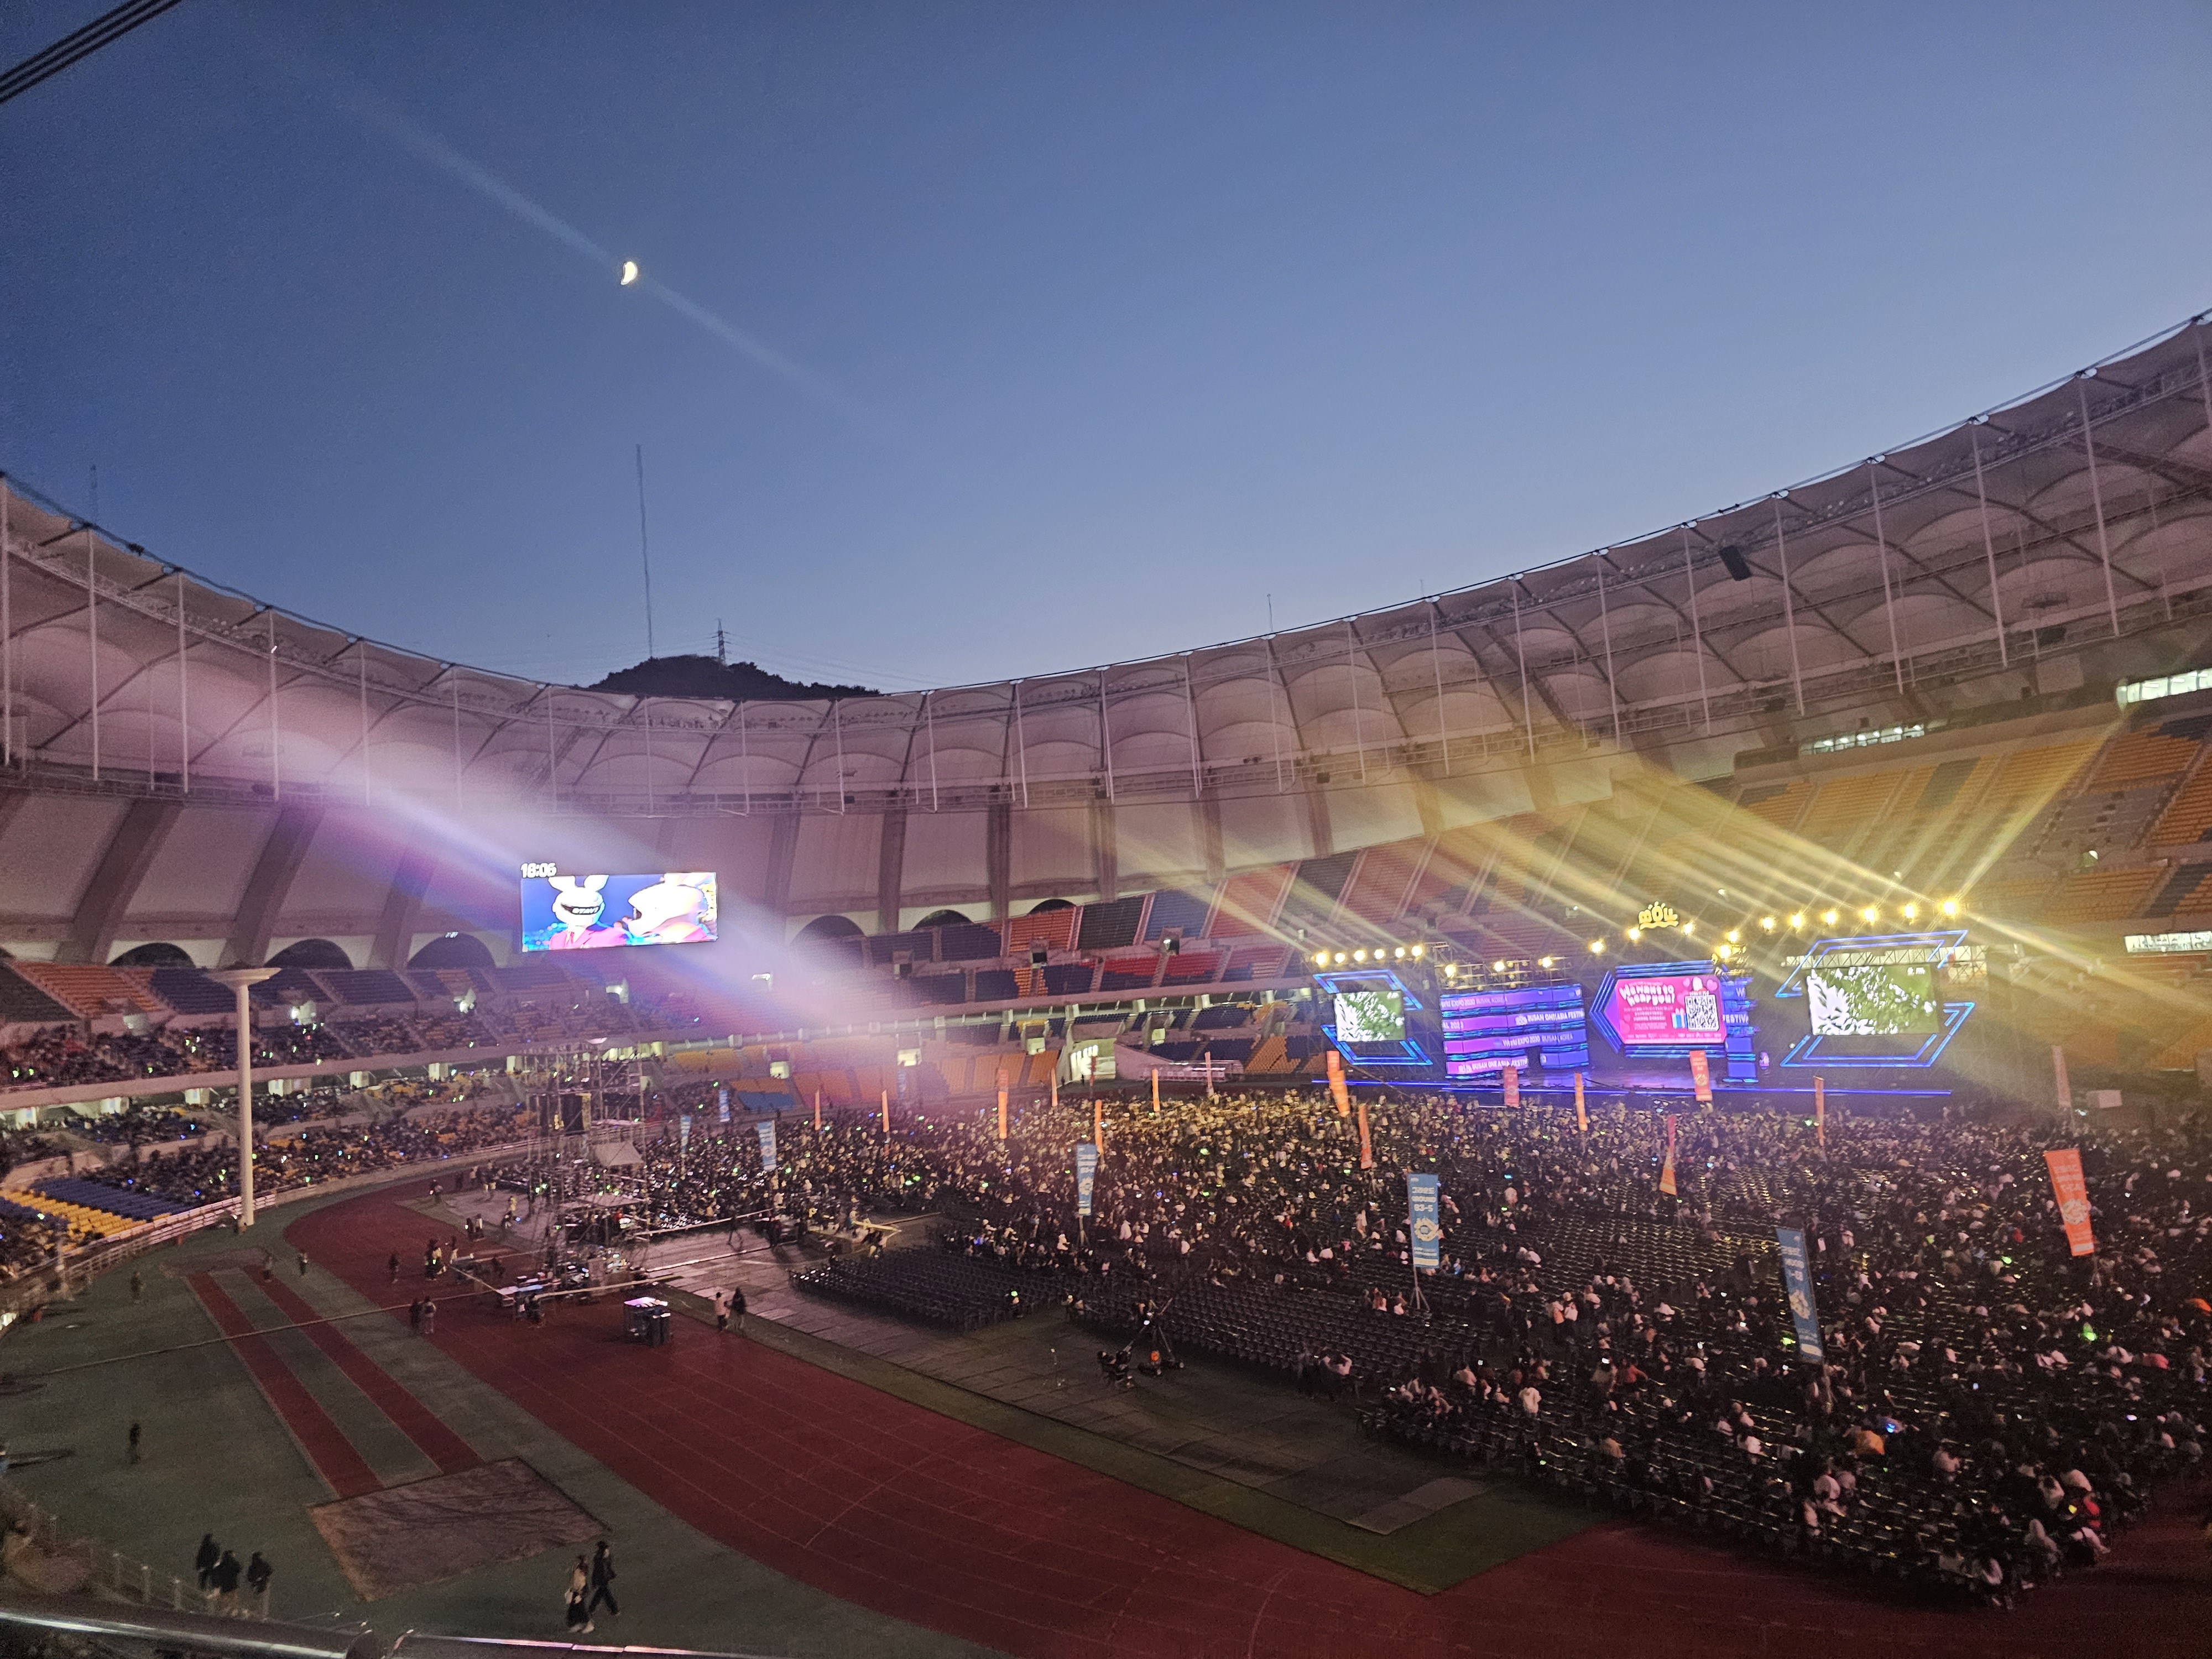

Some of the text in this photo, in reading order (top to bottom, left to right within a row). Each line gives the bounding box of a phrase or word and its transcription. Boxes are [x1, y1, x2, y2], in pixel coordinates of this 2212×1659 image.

[520, 862, 557, 878] 18:06
[1662, 984, 1674, 994] to
[1527, 1013, 1545, 1022] BUSAN
